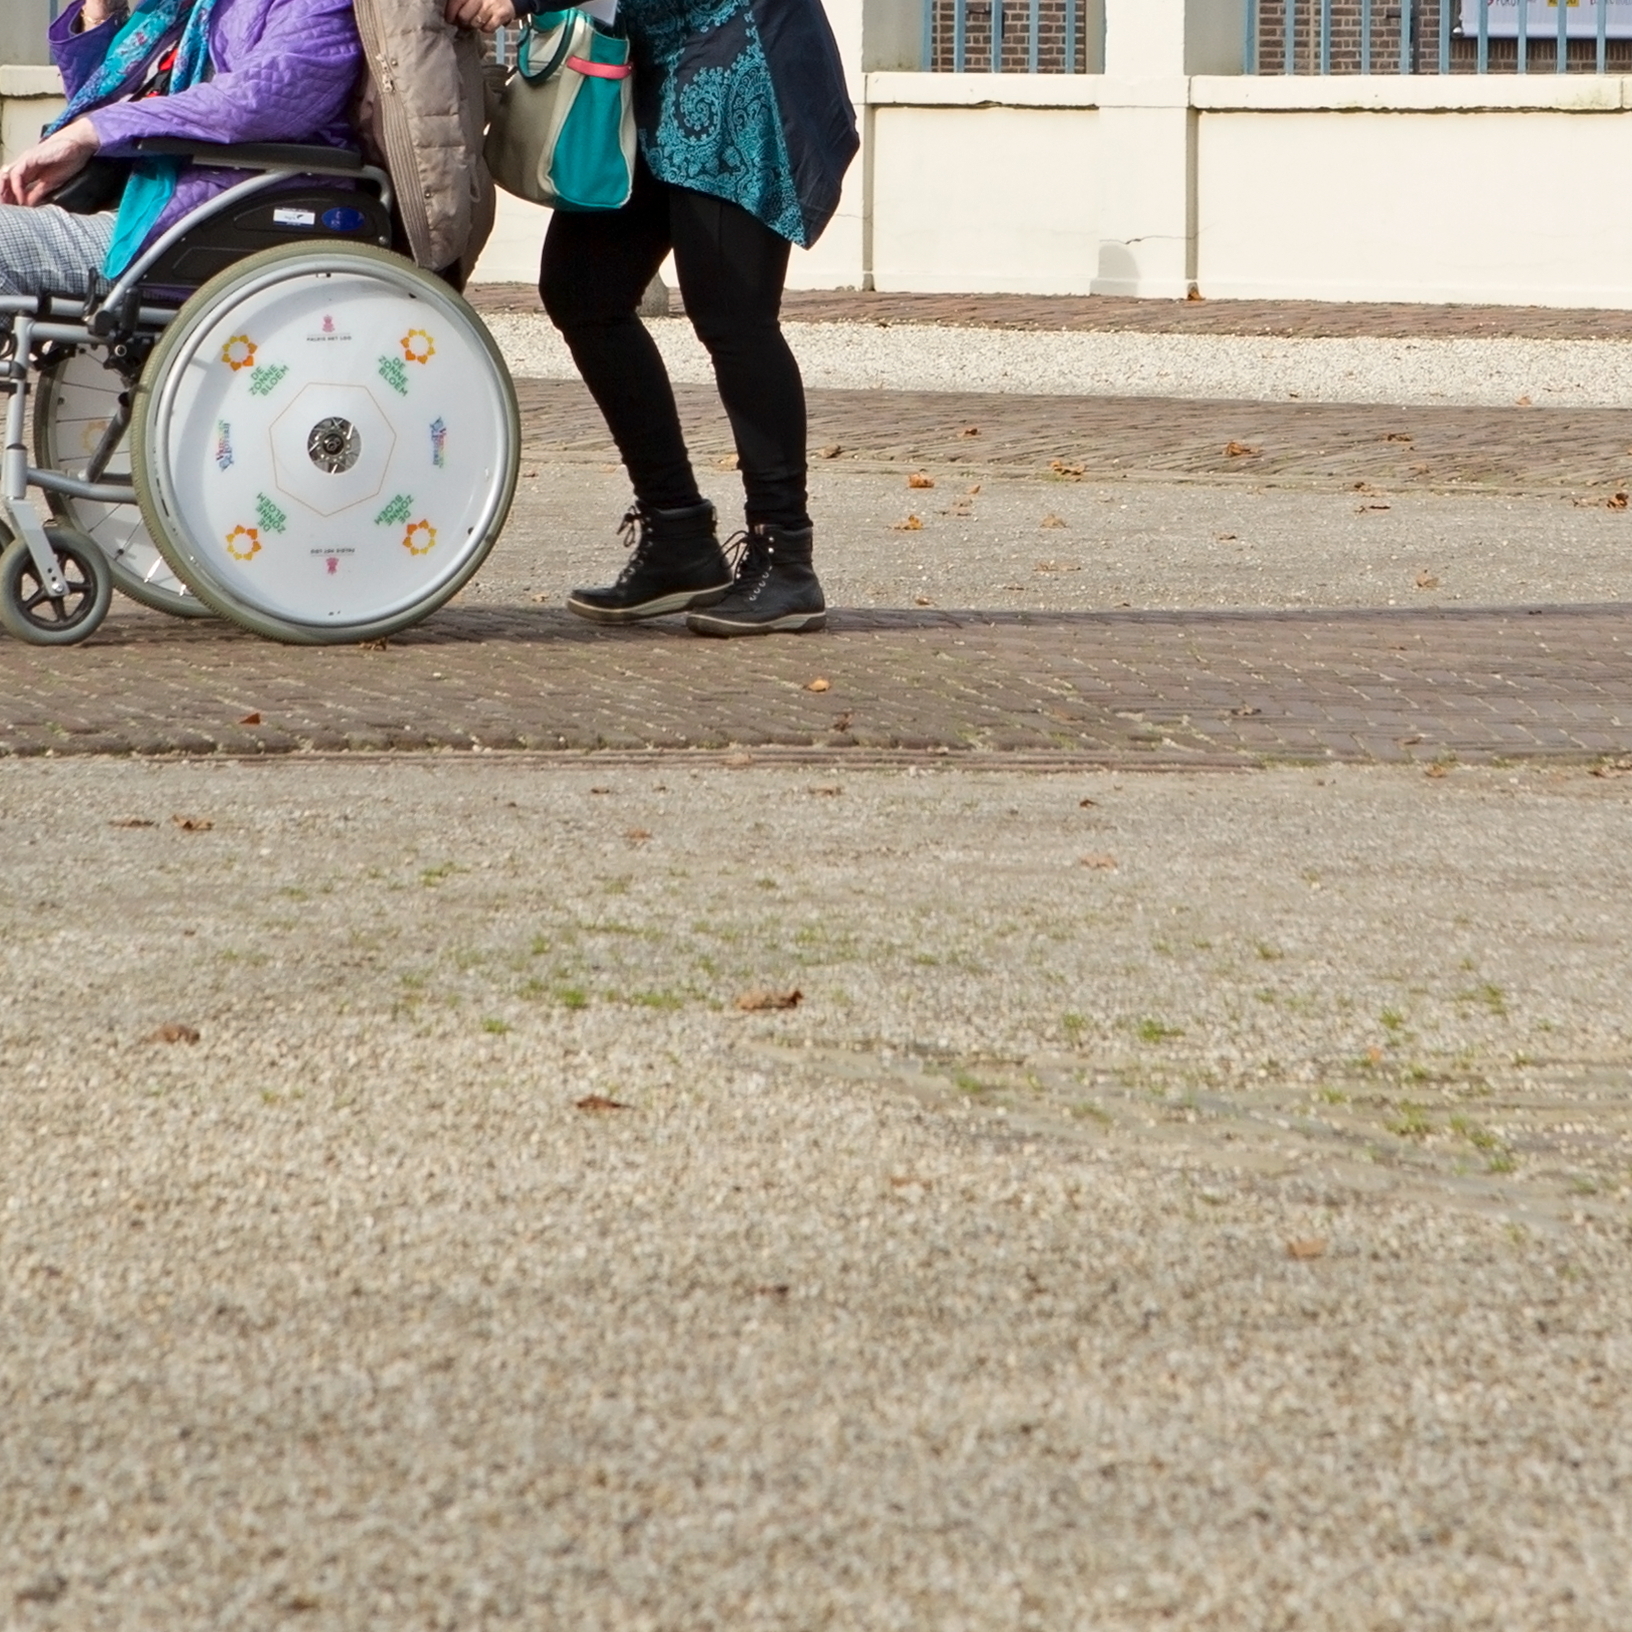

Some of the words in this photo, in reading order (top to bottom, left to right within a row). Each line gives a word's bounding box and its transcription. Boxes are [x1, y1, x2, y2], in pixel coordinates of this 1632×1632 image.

[251, 365, 264, 380] DE
[378, 355, 409, 386] ZONNE
[392, 357, 406, 371] DE
[248, 364, 278, 396] ZONNE
[260, 364, 290, 396] BLOEM
[378, 367, 408, 397] BLOEM
[256, 504, 286, 534] ZONNE
[257, 492, 286, 523] BLOEM
[374, 494, 403, 525] BLOEM
[385, 494, 414, 526] ZONNE
[398, 510, 411, 524] DE
[257, 518, 271, 532] DE
